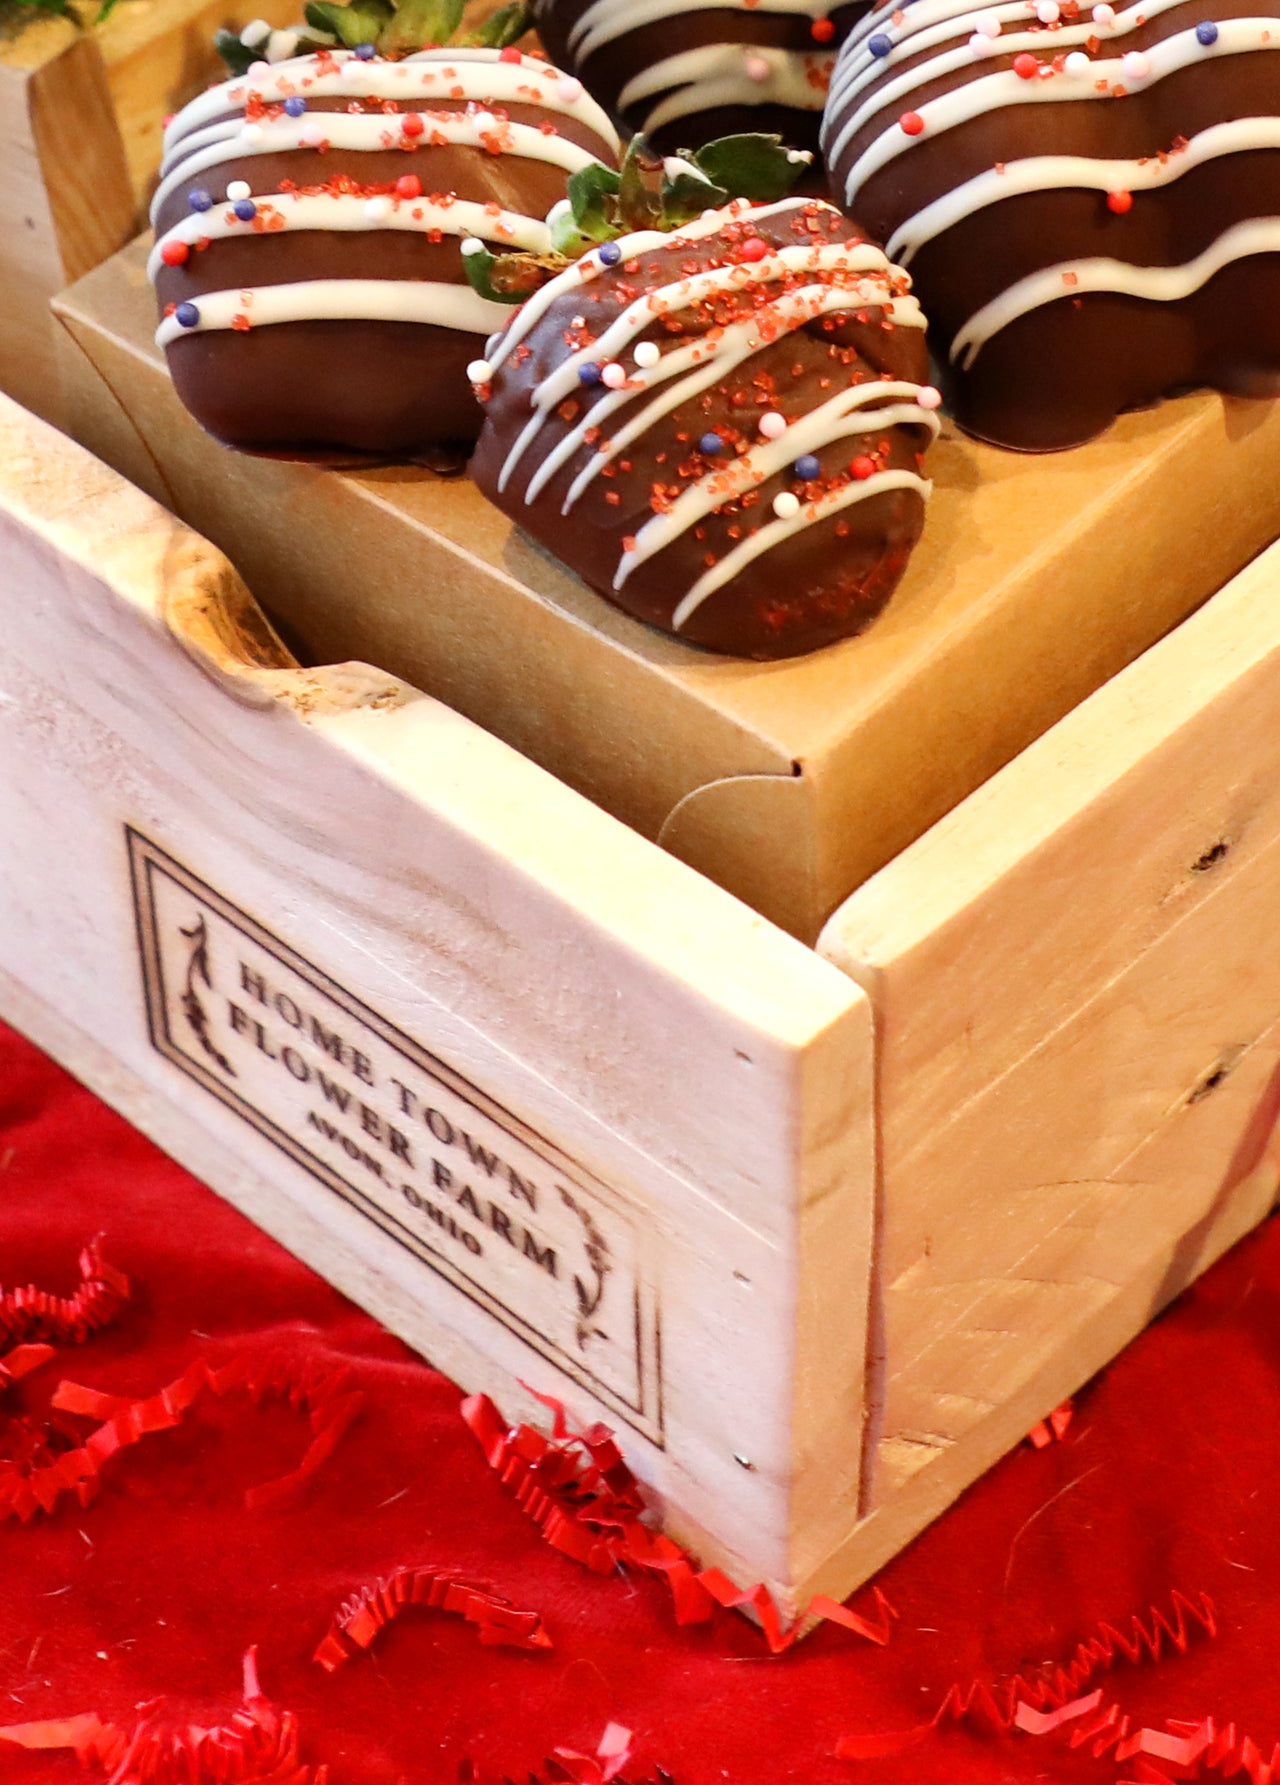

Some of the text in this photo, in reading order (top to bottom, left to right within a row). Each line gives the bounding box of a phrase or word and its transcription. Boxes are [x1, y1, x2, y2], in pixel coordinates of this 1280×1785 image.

[228, 999, 559, 1278] FLOWER FARM
[239, 961, 537, 1212] HOME TOWN
[402, 1183, 482, 1256] OHIO
